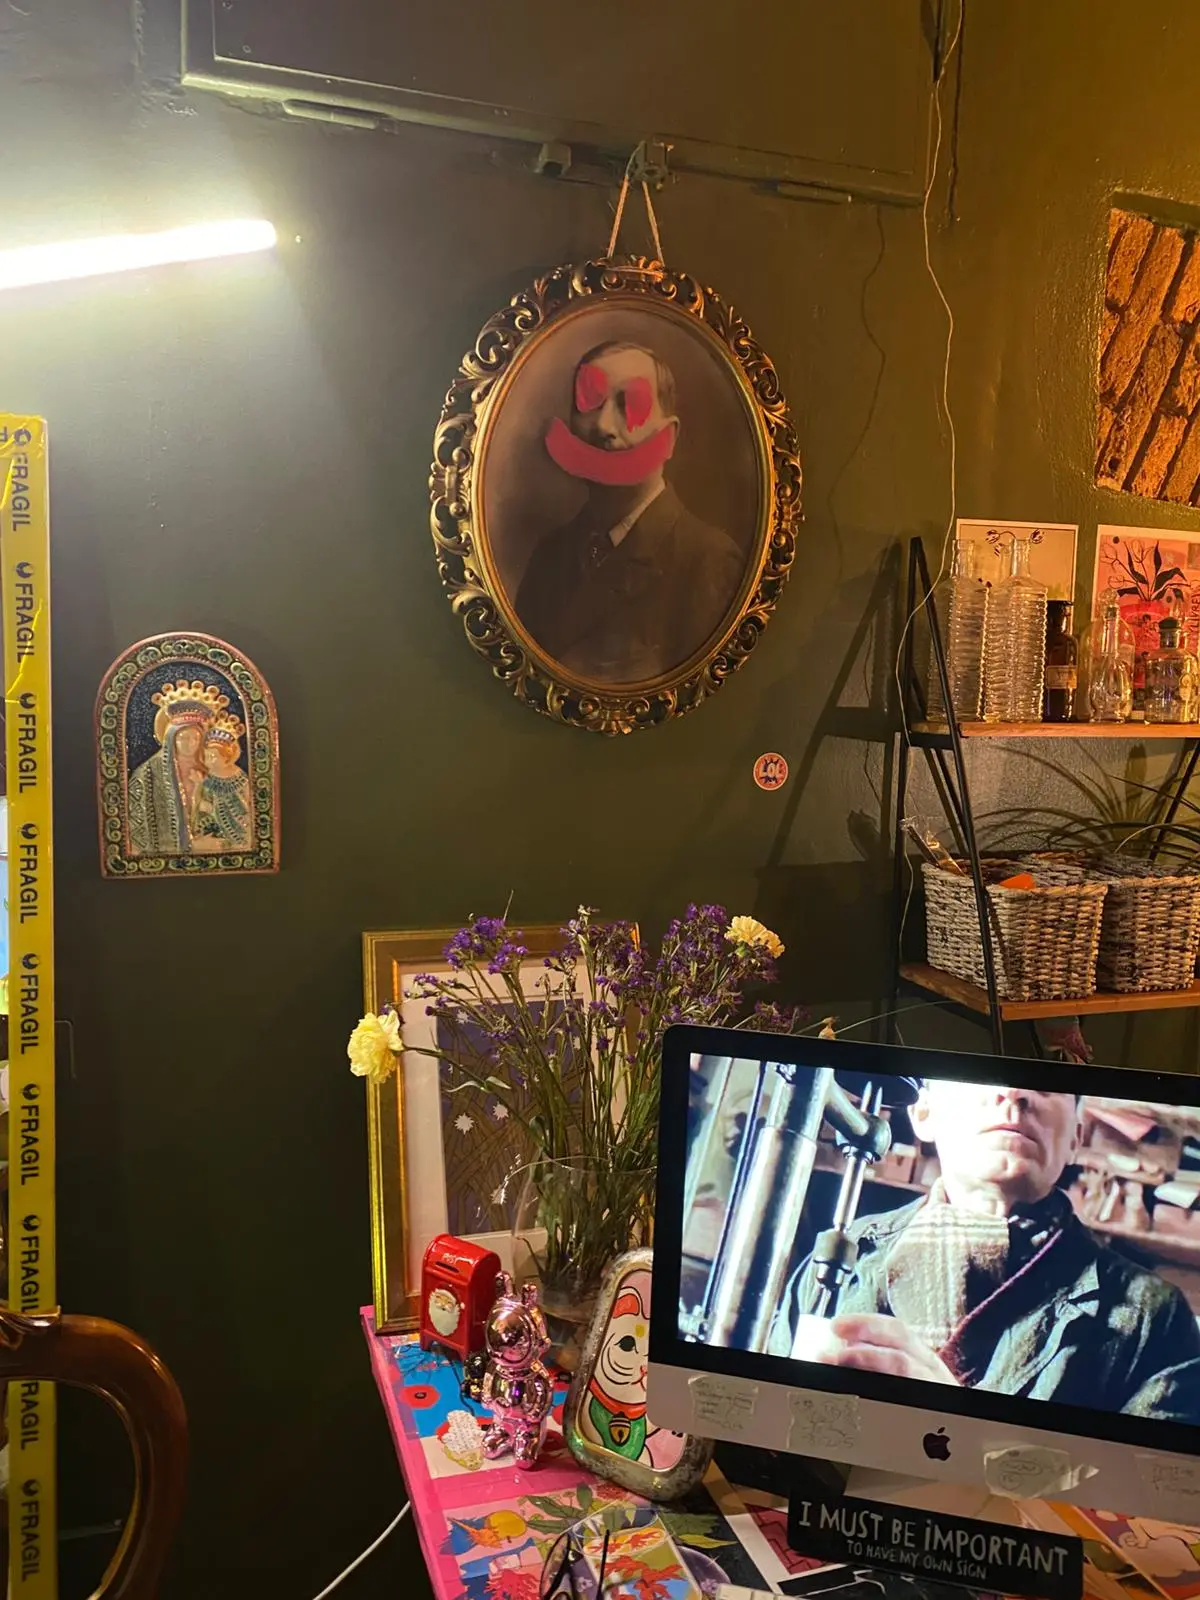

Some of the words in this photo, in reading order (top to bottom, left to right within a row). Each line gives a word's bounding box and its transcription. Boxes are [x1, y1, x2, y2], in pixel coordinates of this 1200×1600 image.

[12, 453, 31, 532] FRAGIL
[15, 582, 35, 663] FRAGIL
[18, 713, 37, 793] FRAGIL
[20, 844, 38, 924] FRAGIL
[20, 974, 39, 1055] FRAGIL
[21, 1104, 39, 1185] FRAGIL
[21, 1236, 40, 1312] FRAGIL
[20, 1381, 40, 1450] RAGIL
[21, 1501, 40, 1583] FRAGIL
[799, 1501, 812, 1527] I
[820, 1503, 883, 1538] MUST
[891, 1518, 916, 1548] BE
[847, 1540, 862, 1556] TO
[866, 1544, 897, 1563] HAVE
[900, 1551, 919, 1570] MY
[923, 1556, 952, 1573] OWN
